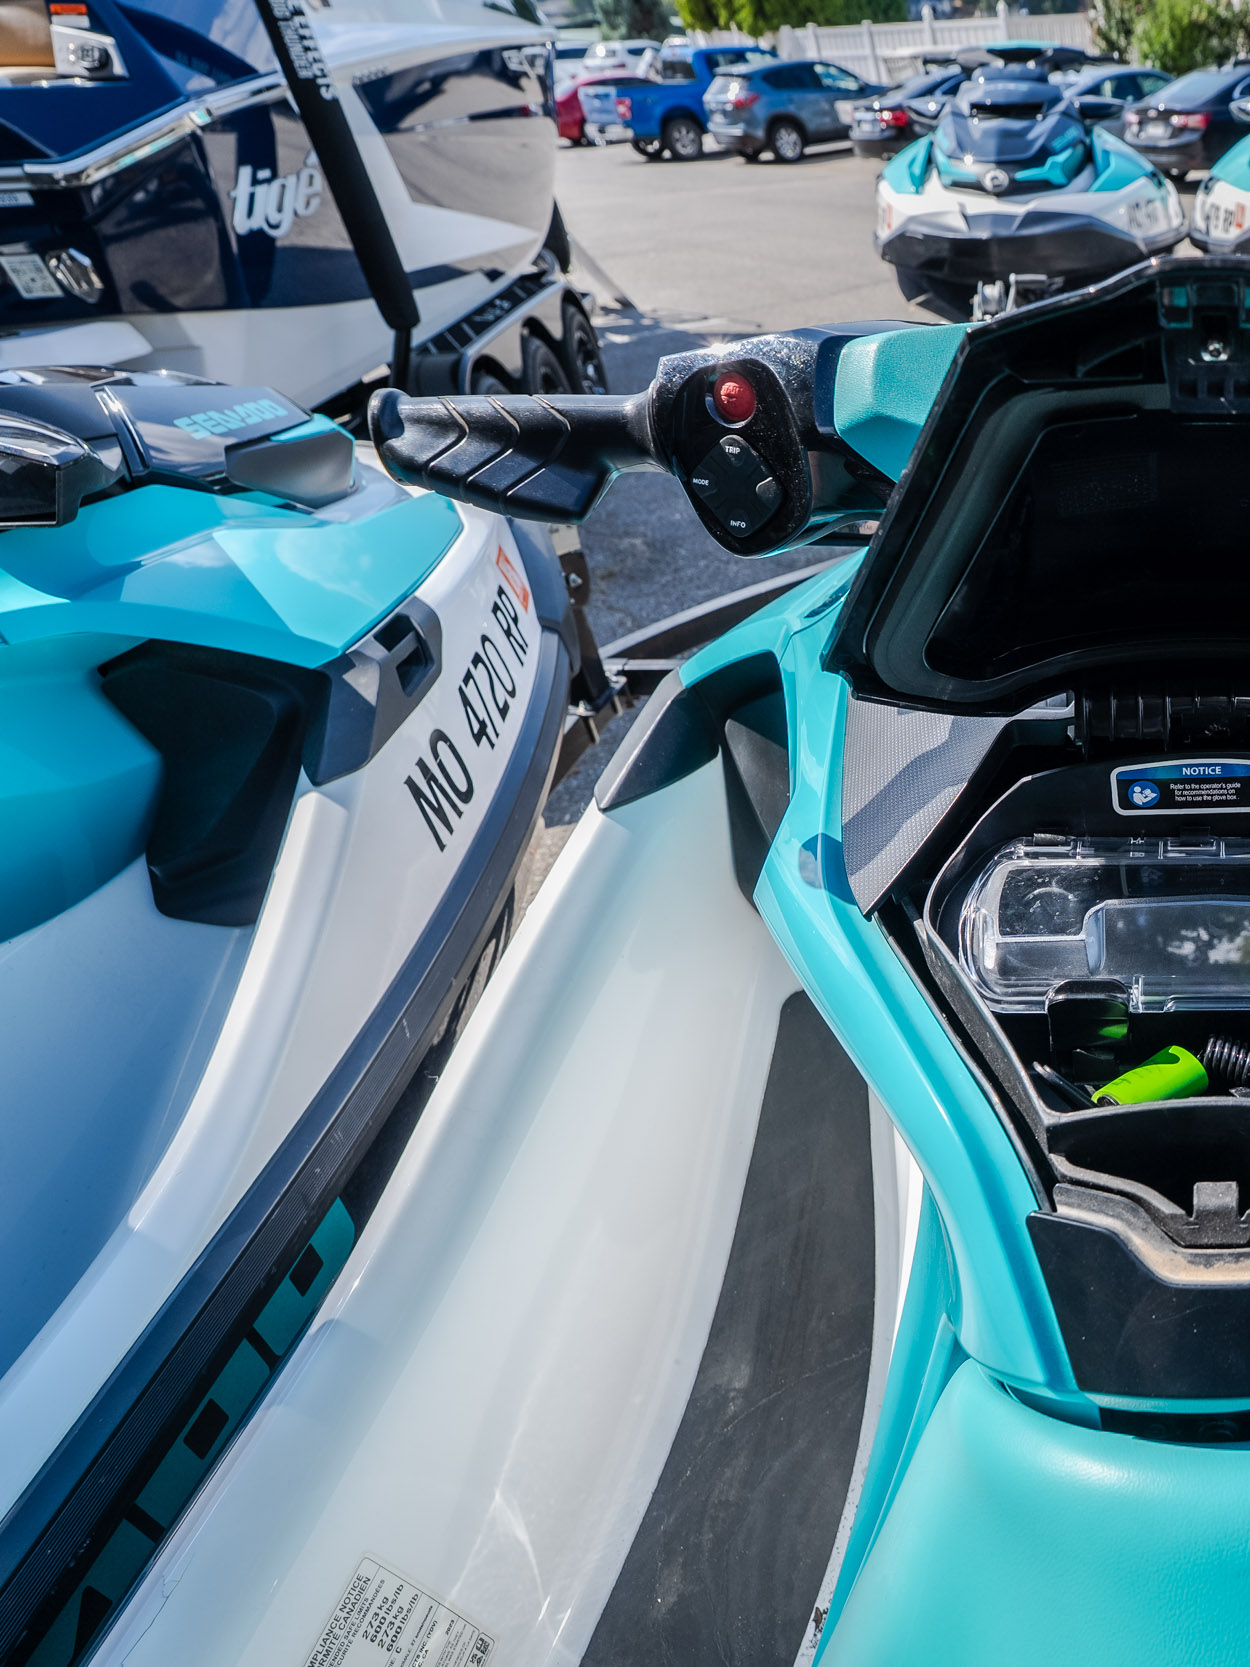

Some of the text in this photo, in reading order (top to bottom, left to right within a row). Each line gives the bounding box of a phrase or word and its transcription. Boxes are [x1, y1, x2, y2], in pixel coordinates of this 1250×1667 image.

[724, 445, 741, 455] TRIP
[692, 478, 709, 486] MODE
[730, 519, 746, 529] INFO
[403, 729, 474, 852] MO
[458, 634, 516, 750] 4720
[491, 584, 528, 667] RP
[1182, 766, 1222, 776] NOTICE
[1182, 788, 1228, 796] recommendations
[1200, 782, 1226, 791] operator's
[1226, 782, 1241, 790] guide
[1212, 794, 1227, 802] glove
[339, 1573, 364, 1613] NOTICE
[369, 1584, 404, 1643] 600 lbs/lb
[317, 1576, 371, 1667] RMITÉ CANADIEN
[328, 1597, 369, 1667] ENDED SAFE LIMITS
[334, 1579, 385, 1667] CURITÉ RECOMMANDÉES
[362, 1596, 389, 1640] 273 kg
[377, 1605, 404, 1649] 273 kg
[386, 1593, 419, 1652] 600 lbs/lb
